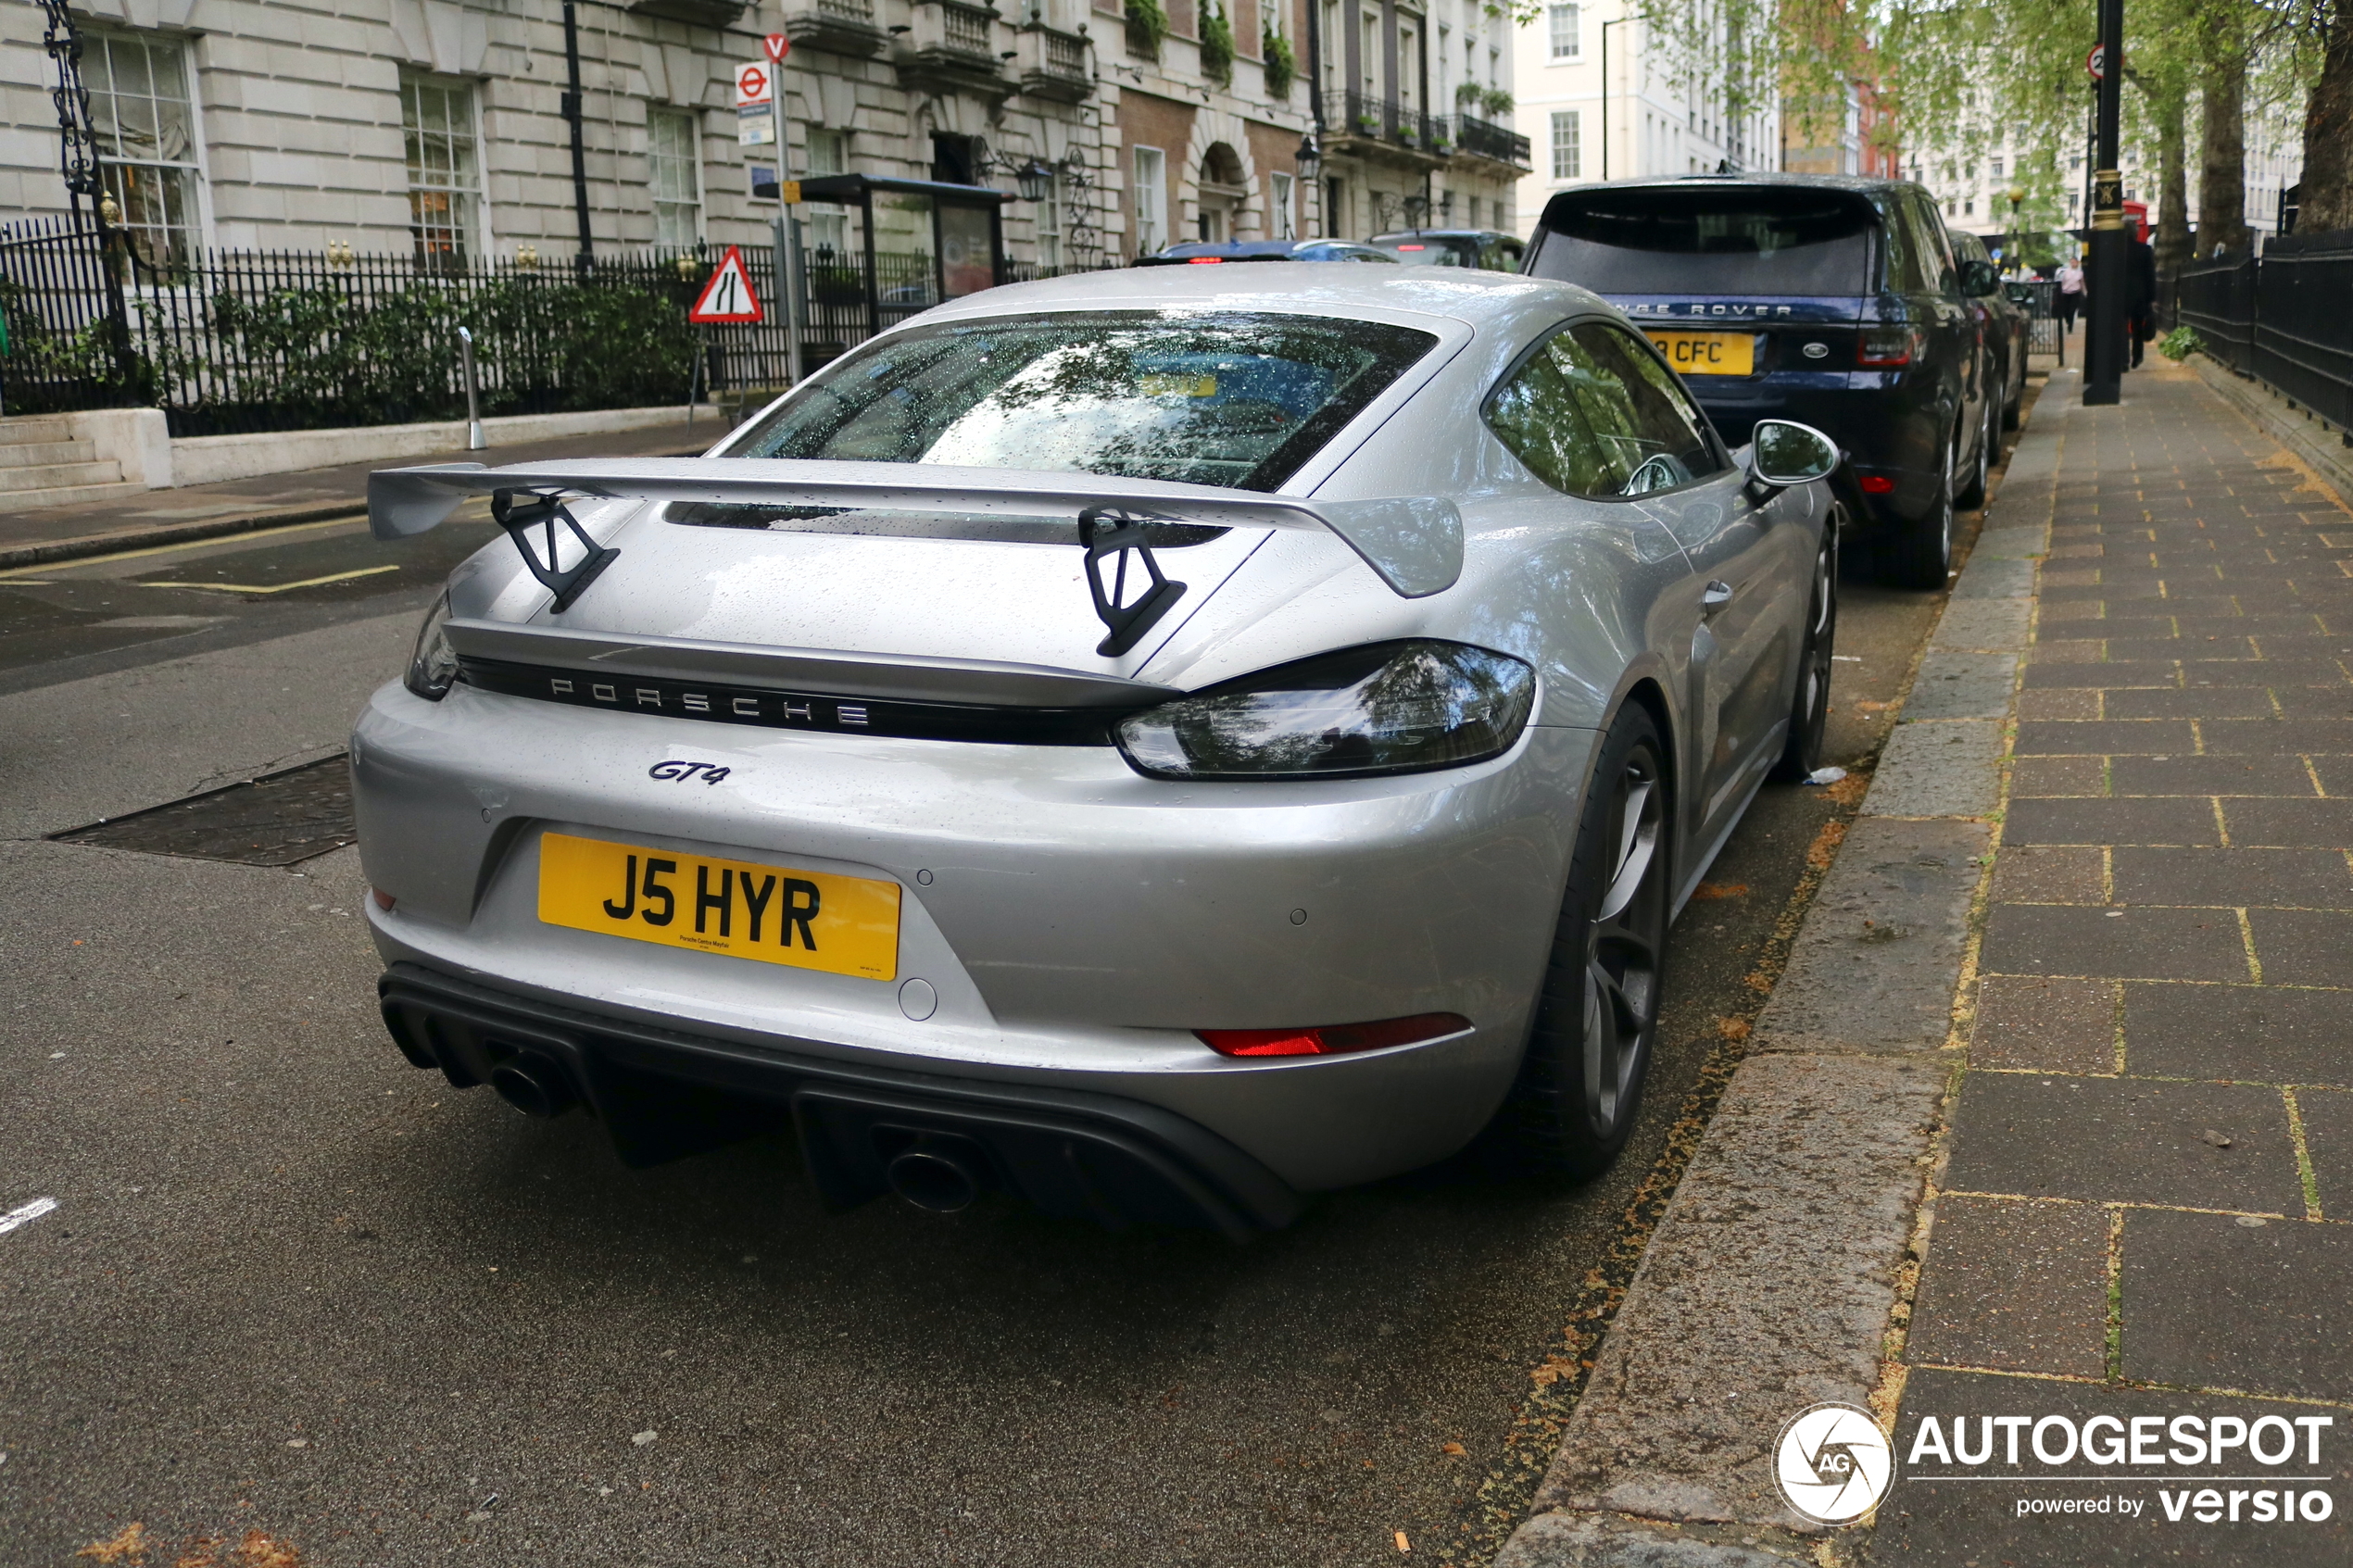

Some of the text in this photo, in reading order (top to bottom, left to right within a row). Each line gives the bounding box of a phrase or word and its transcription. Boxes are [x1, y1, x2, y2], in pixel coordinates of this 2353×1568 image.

[766, 37, 785, 57] V
[2094, 55, 2104, 69] 2
[1616, 304, 1792, 316] NGE ROVER
[1676, 340, 1722, 364] CFC
[550, 678, 869, 726] PORSCHE
[648, 760, 731, 785] GT4
[603, 855, 821, 952] J5 HYR
[679, 935, 697, 944] Porsche
[698, 937, 712, 946] Centre
